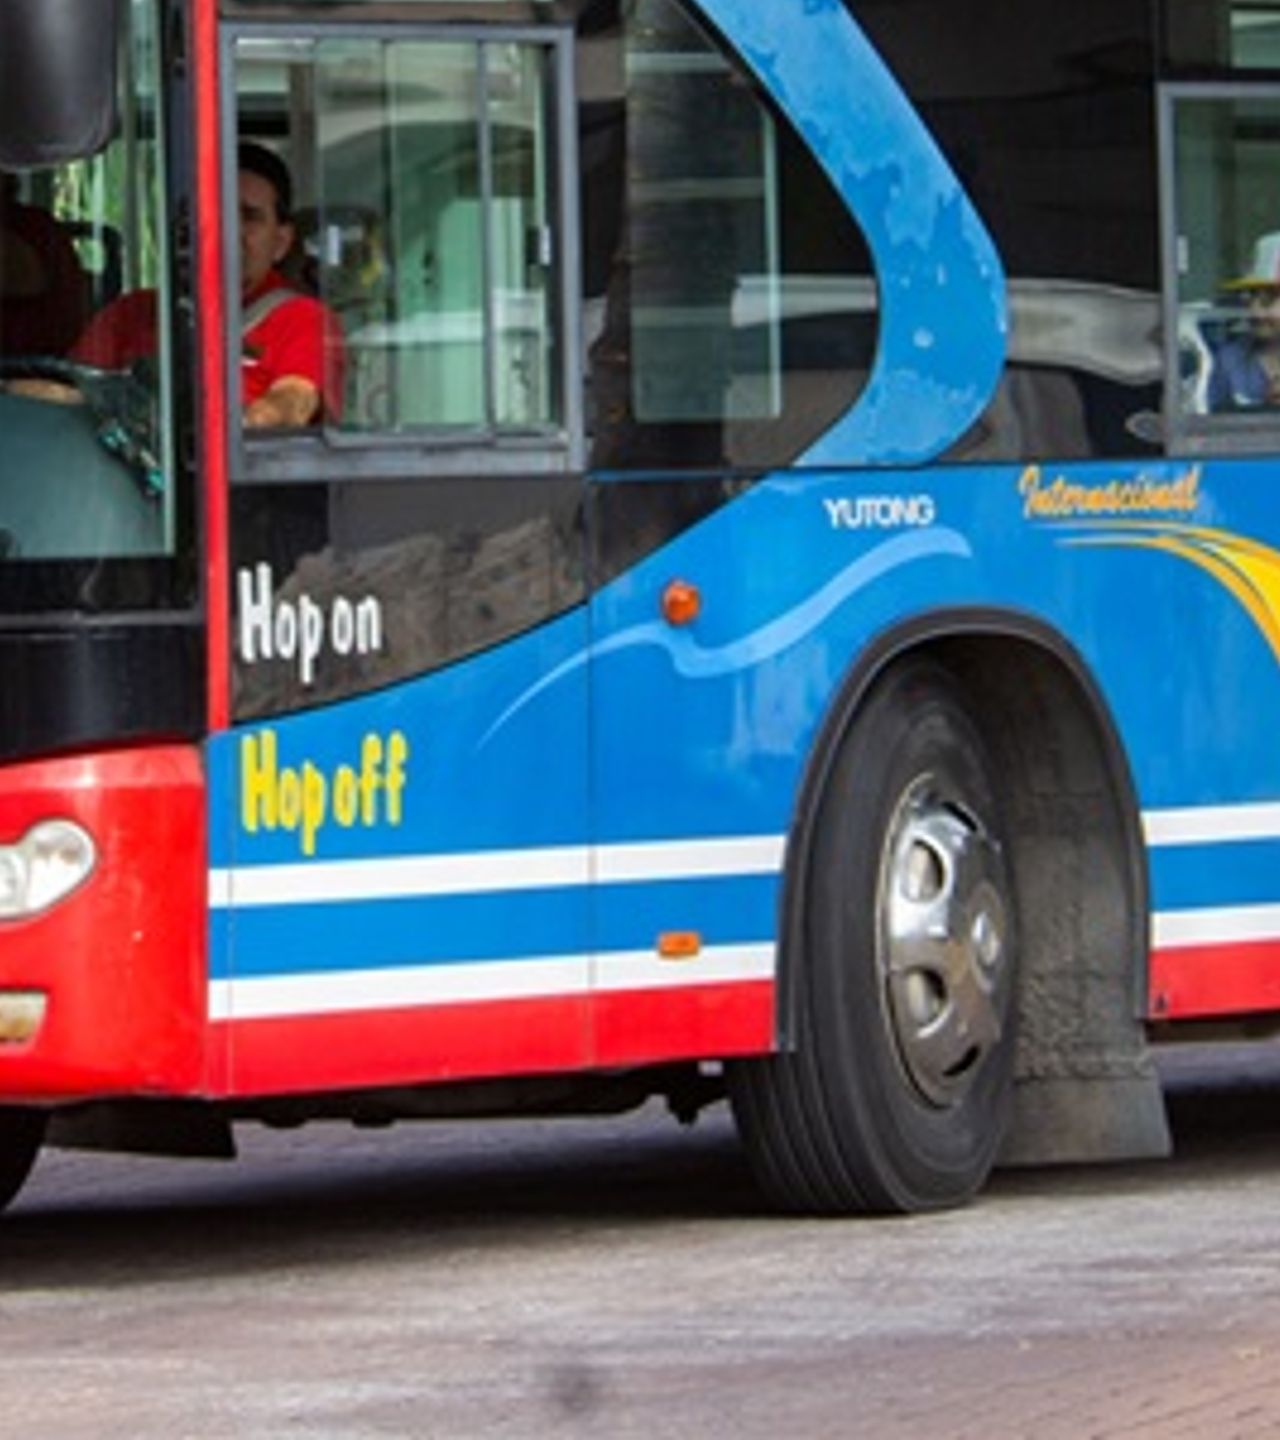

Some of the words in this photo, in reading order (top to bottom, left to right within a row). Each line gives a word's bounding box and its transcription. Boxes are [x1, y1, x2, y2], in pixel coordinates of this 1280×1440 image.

[823, 495, 936, 528] YUTONG
[236, 562, 322, 684] Hop
[330, 596, 383, 654] on
[240, 728, 327, 856] Hop
[332, 731, 410, 826] off
